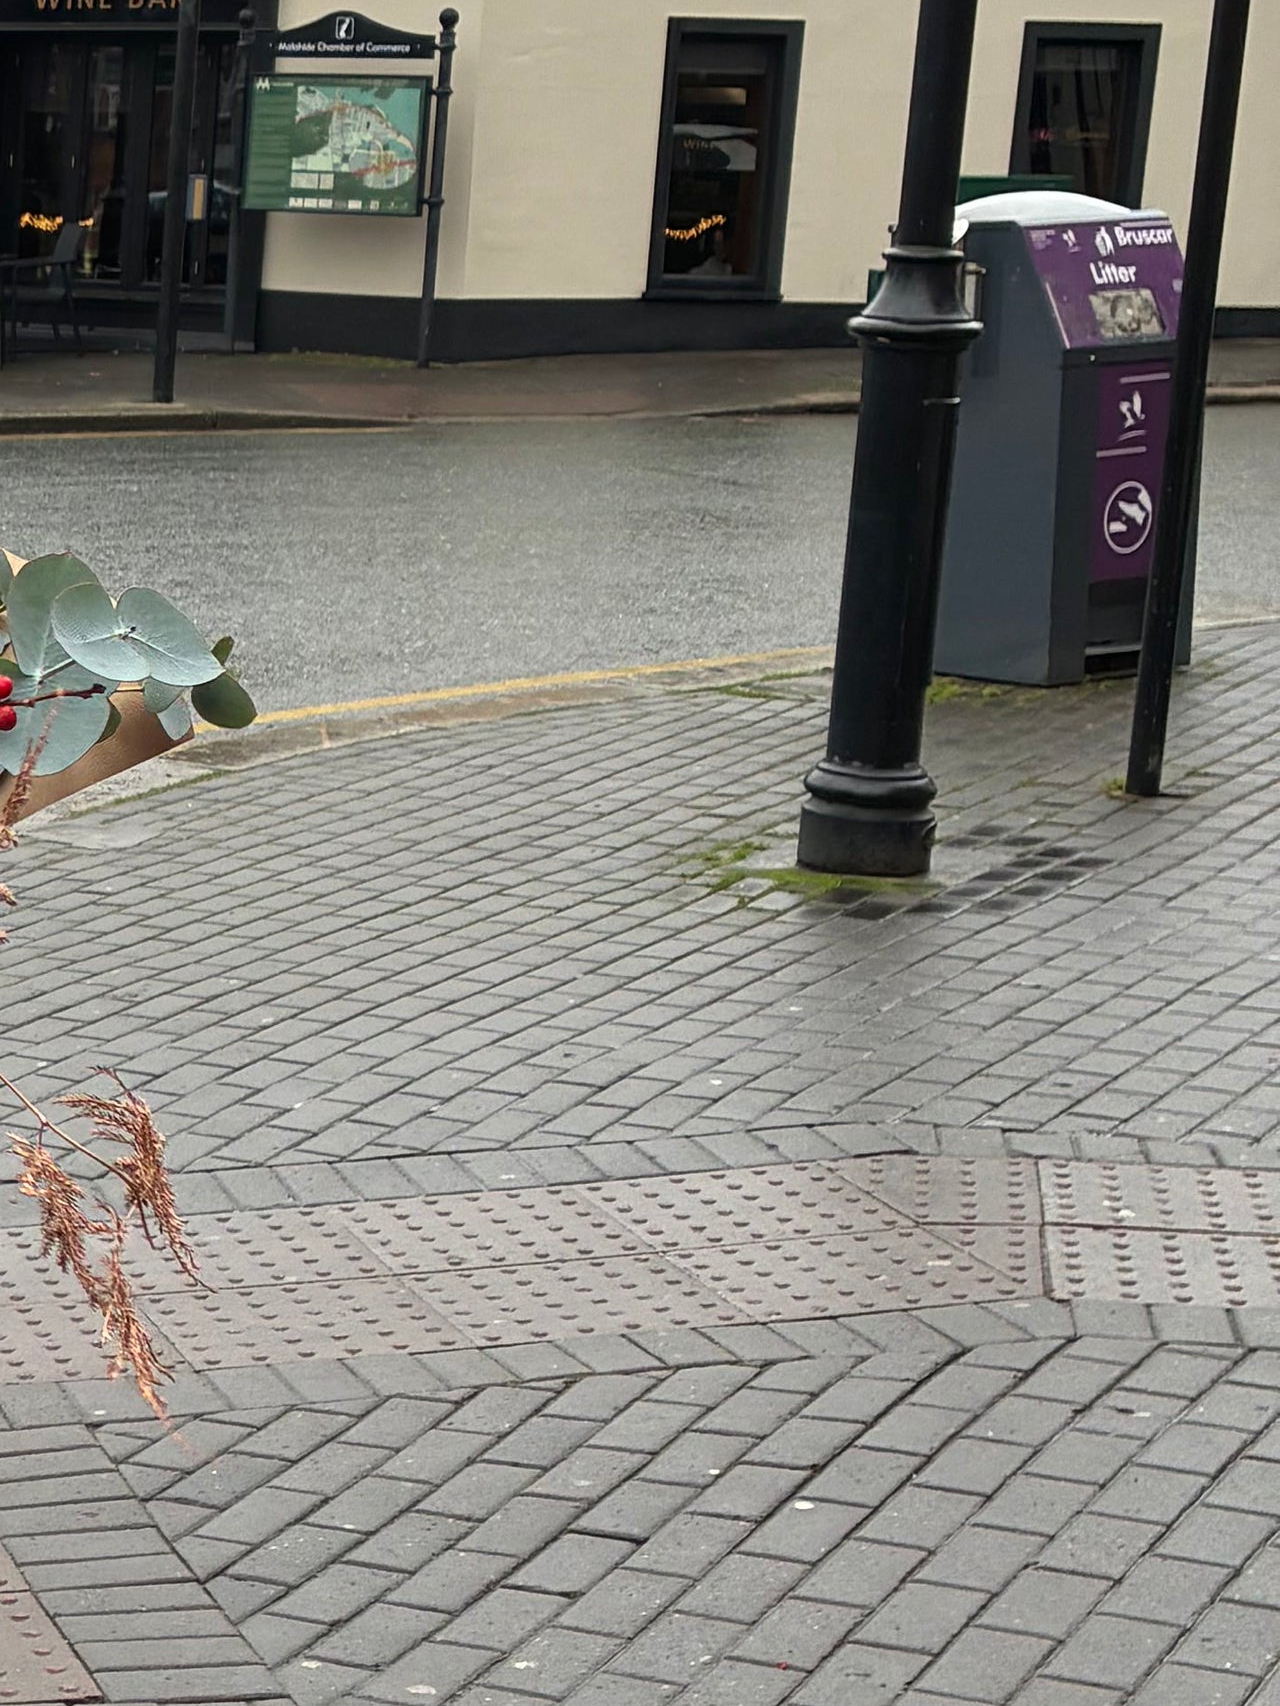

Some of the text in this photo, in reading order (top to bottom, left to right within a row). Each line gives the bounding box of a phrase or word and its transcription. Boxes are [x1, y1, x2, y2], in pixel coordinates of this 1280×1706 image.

[278, 40, 411, 54] Malahide Chamber of Commerce
[1114, 225, 1173, 247] Bruscar
[1089, 261, 1137, 285] Litter
